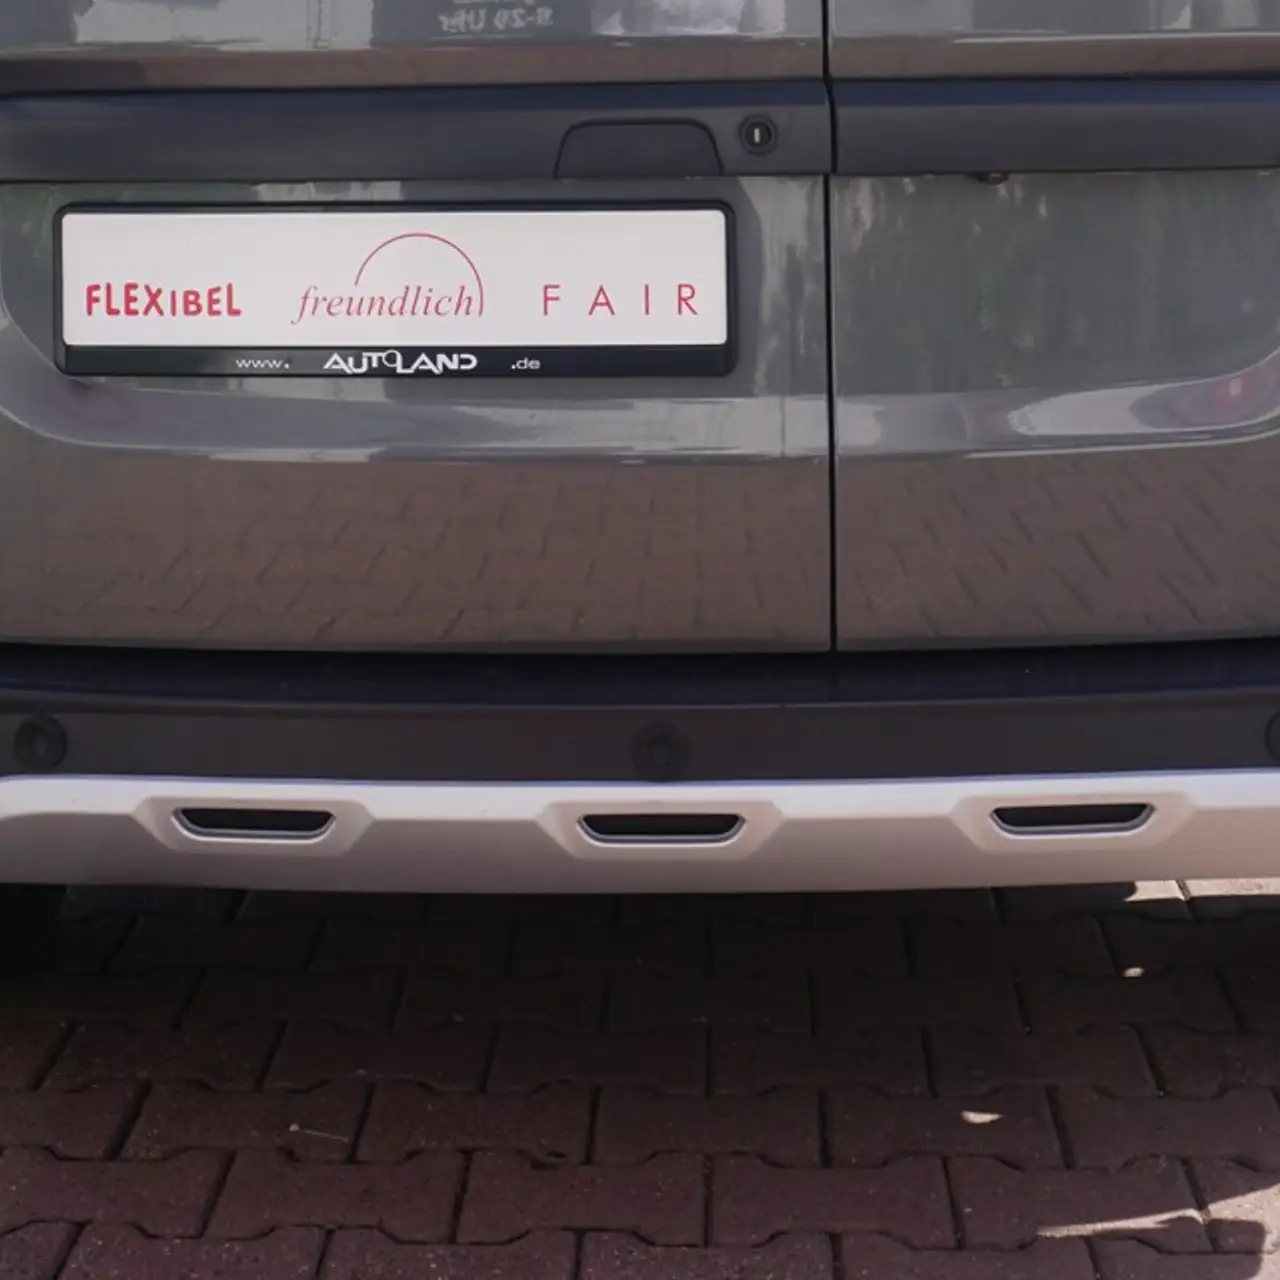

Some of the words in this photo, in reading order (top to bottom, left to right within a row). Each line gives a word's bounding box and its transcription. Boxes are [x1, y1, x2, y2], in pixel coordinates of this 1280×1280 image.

[85, 282, 242, 318] FLEXIBEL
[290, 284, 475, 325] freundlich
[235, 357, 290, 370] www.
[323, 349, 478, 375] AUTOLAND
[510, 357, 541, 370] .de
